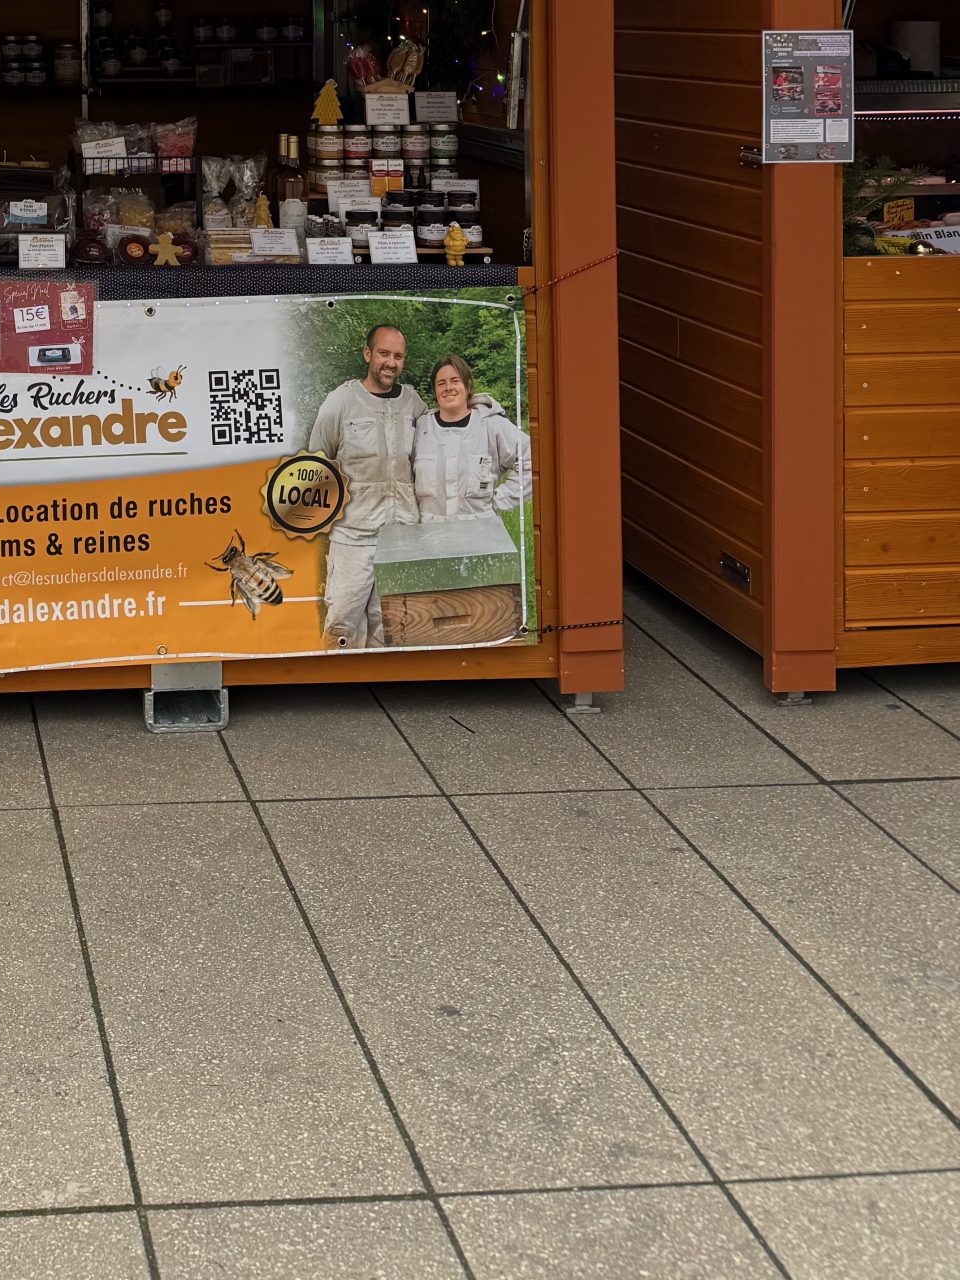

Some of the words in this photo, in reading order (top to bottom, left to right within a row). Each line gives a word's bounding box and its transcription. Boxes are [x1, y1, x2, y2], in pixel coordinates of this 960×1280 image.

[19, 307, 46, 322] 15€
[27, 379, 117, 410] Ruchers
[297, 468, 324, 483] 100%
[109, 496, 138, 520] de
[148, 492, 232, 518] ruches
[278, 485, 331, 509] LOCAL
[45, 532, 64, 557] &
[72, 530, 150, 555] reines
